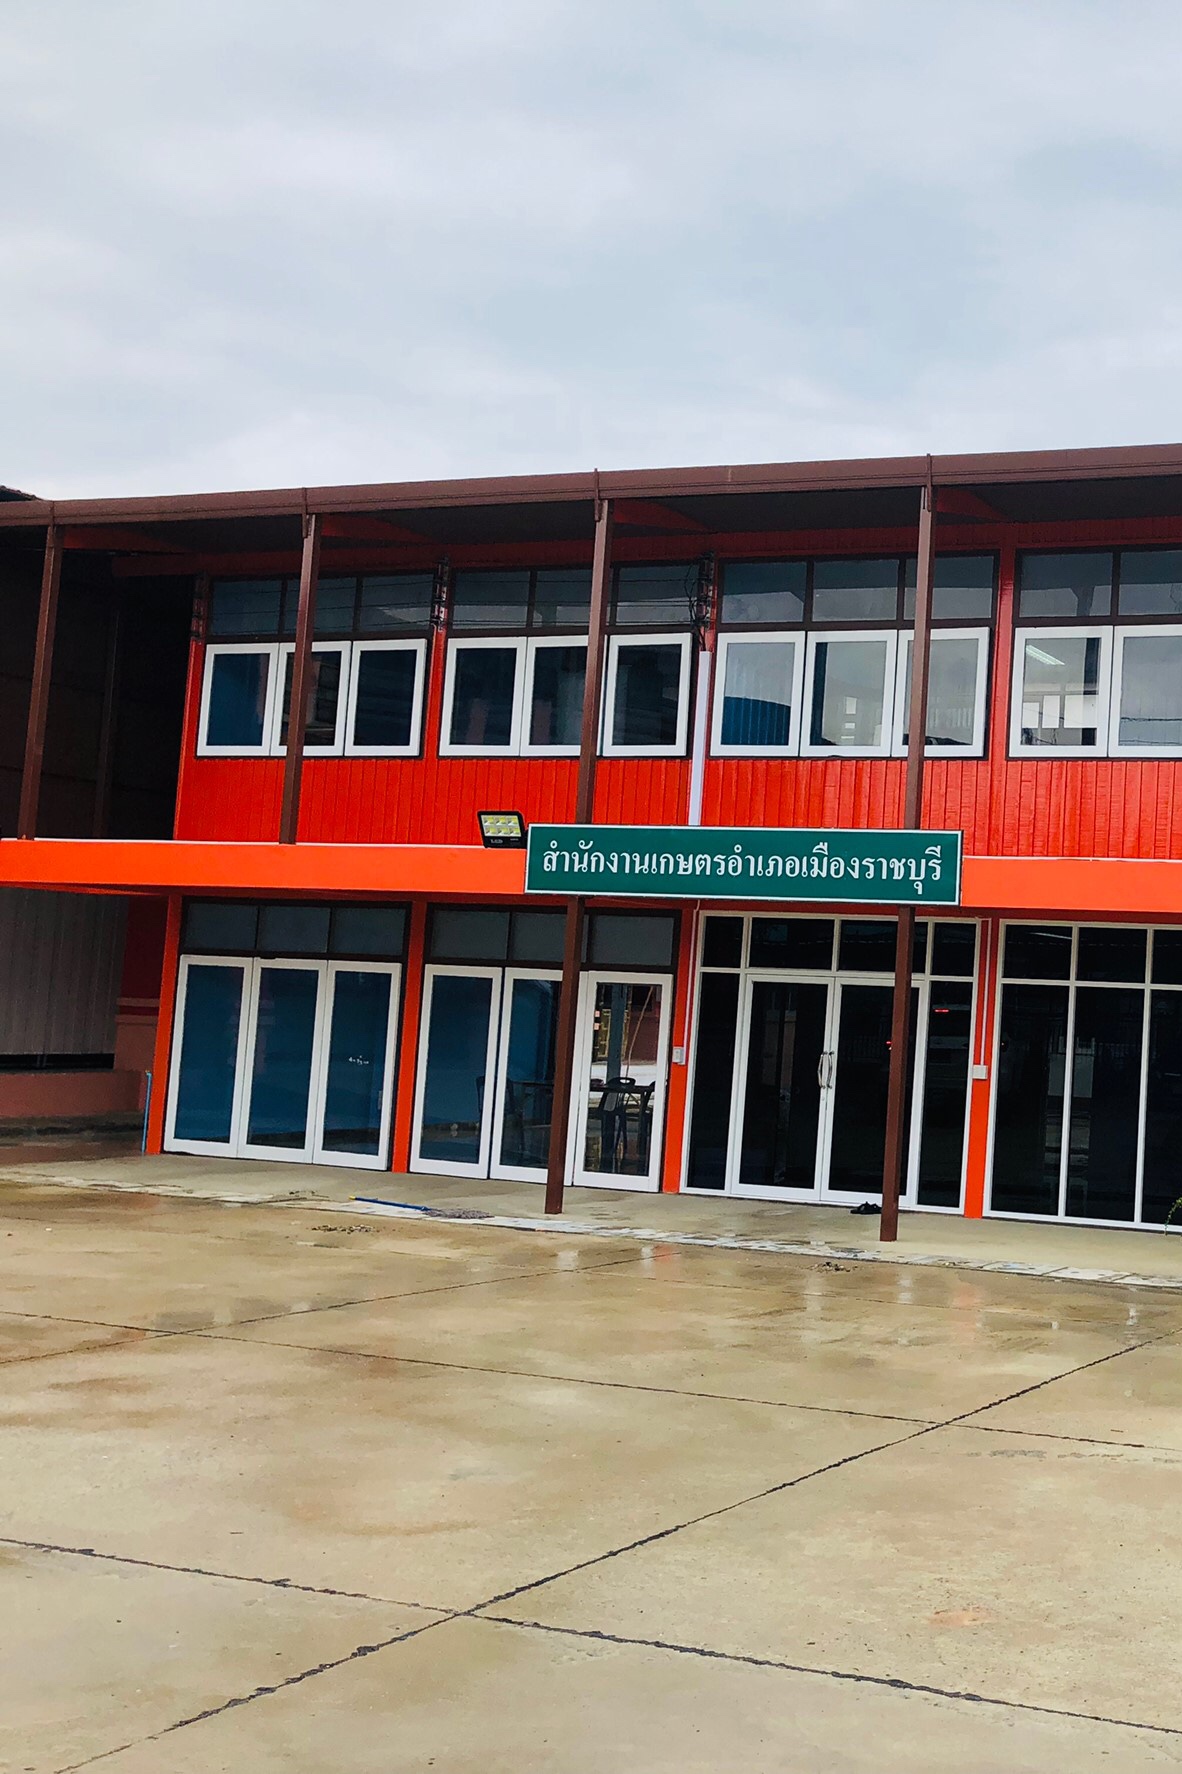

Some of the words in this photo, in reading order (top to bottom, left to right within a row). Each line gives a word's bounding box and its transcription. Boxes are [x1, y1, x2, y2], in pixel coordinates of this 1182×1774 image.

[542, 839, 942, 895] สำนักงานเกษตรอำเภอเมืองราชบุรี
